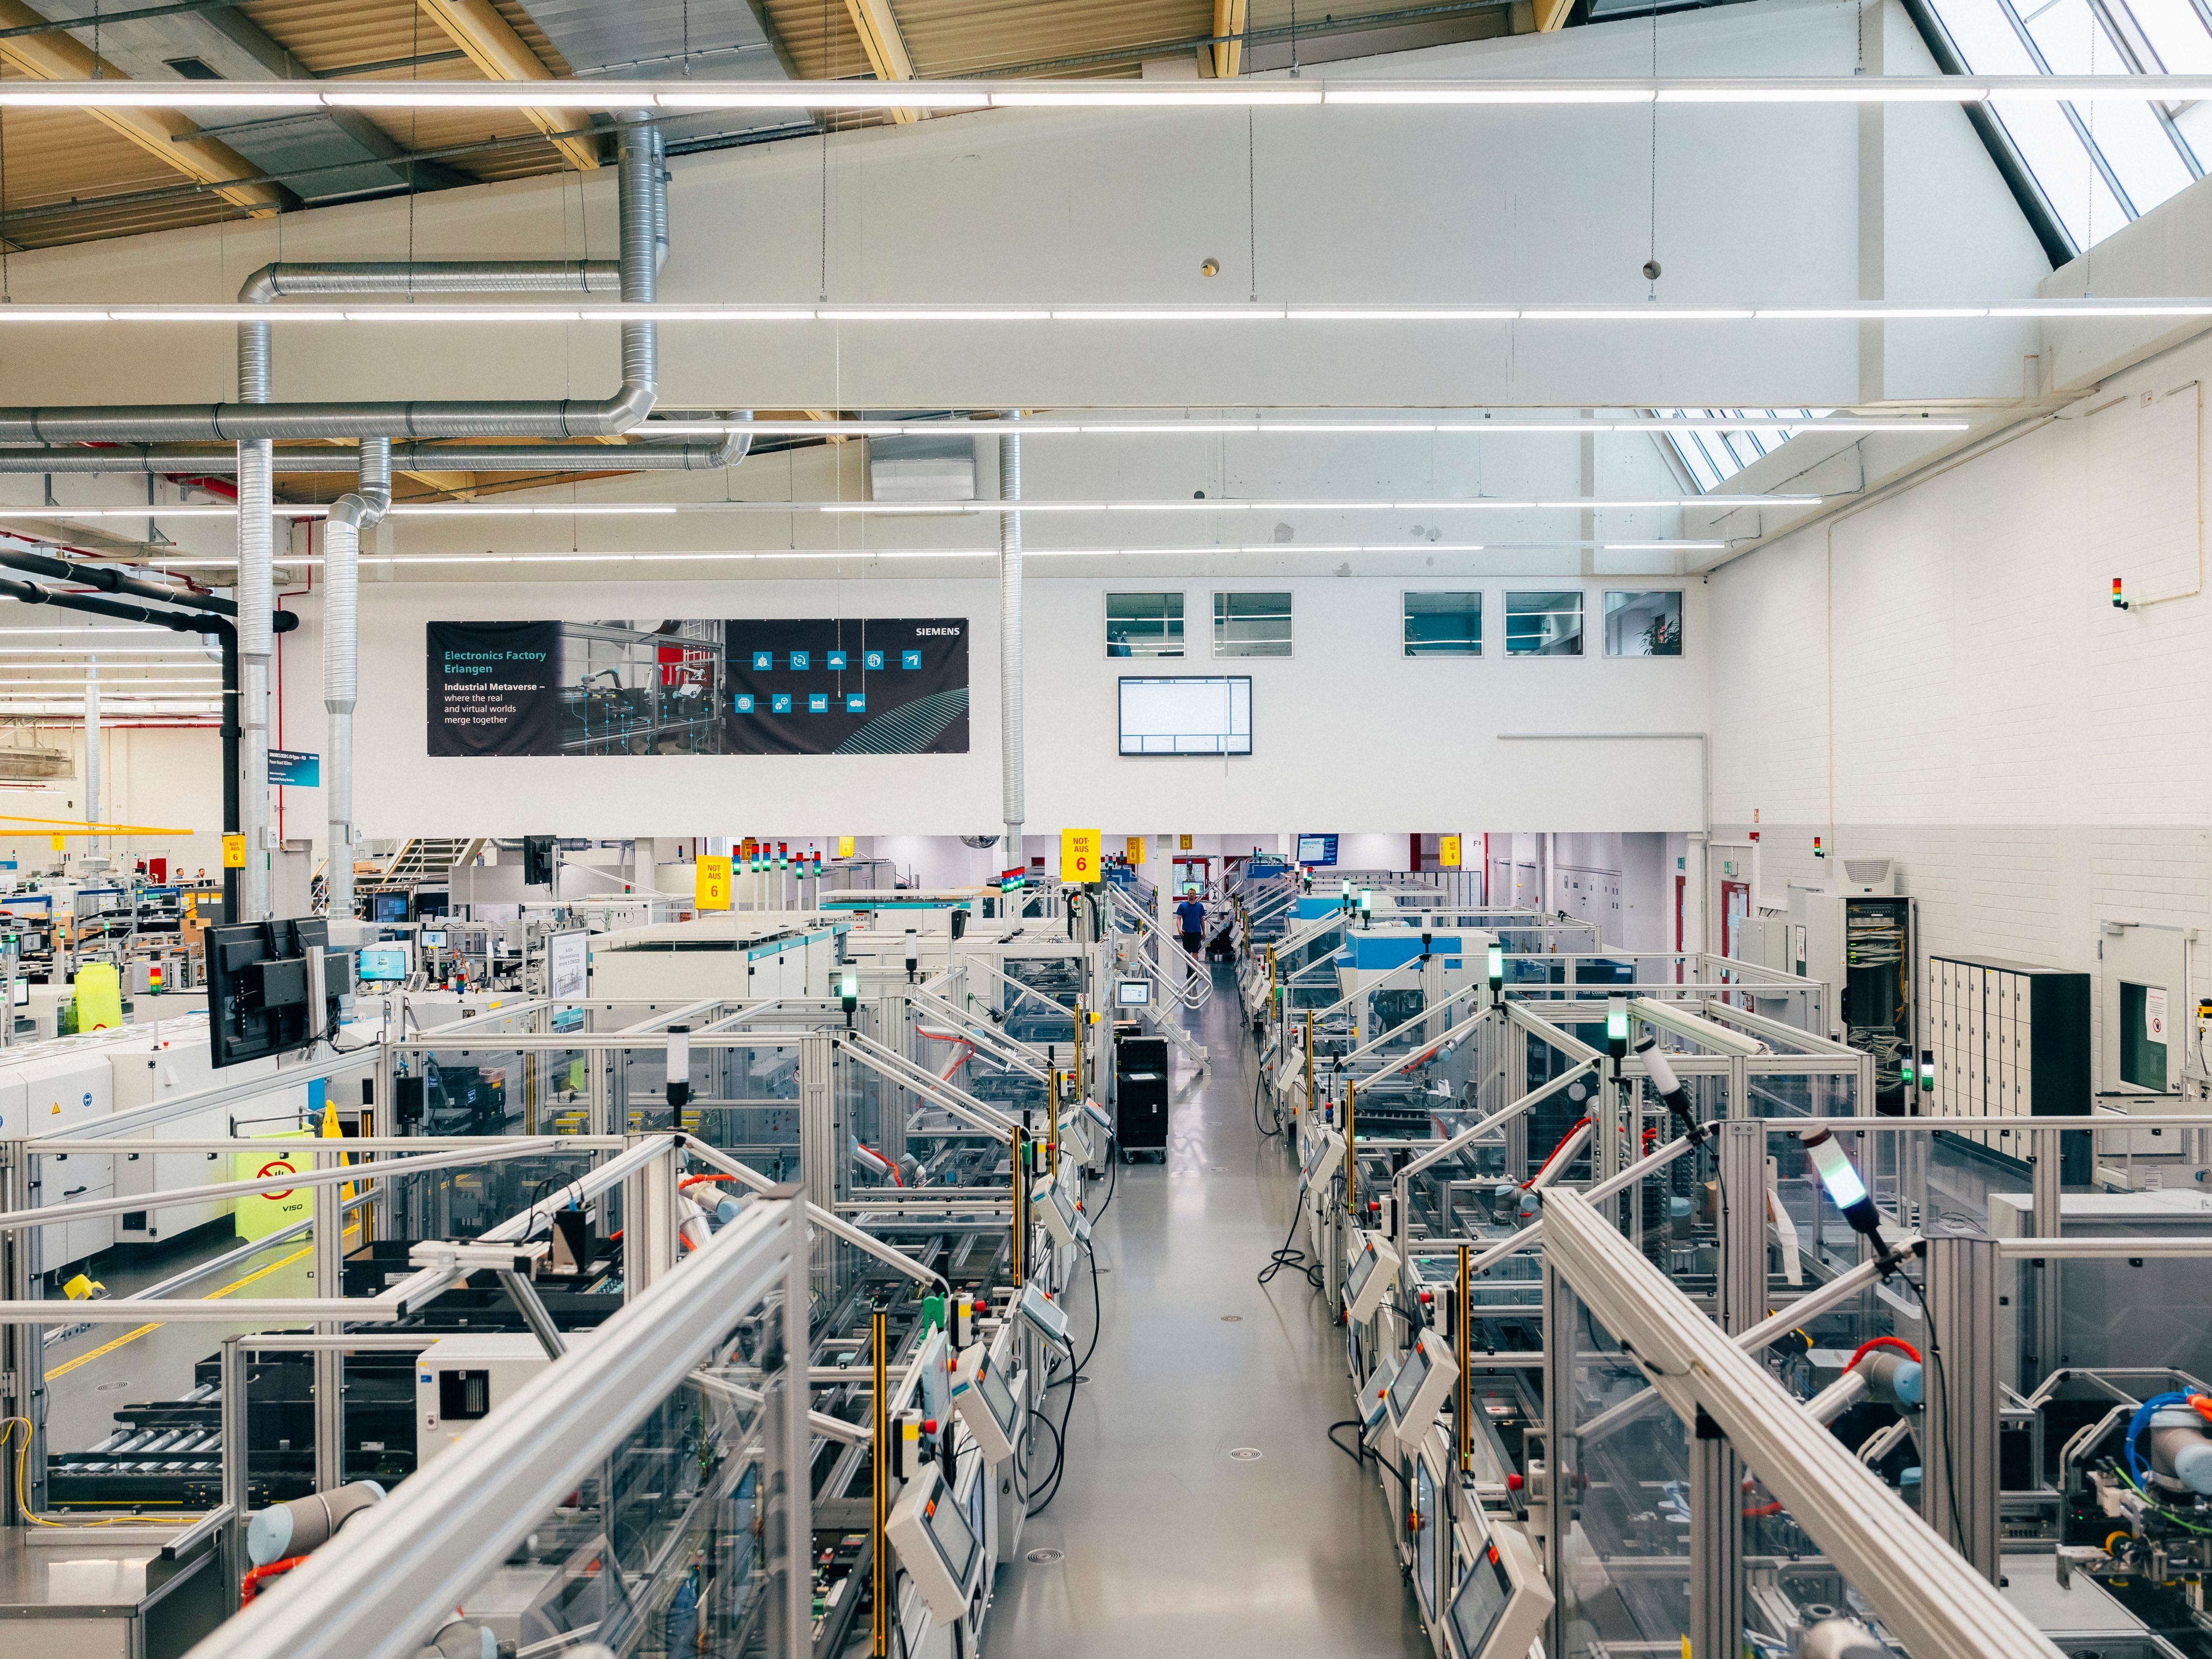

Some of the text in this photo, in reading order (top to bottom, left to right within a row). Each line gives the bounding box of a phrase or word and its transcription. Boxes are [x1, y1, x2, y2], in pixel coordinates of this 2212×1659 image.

[916, 627, 960, 636] SIEMENS
[445, 651, 546, 662] Electronics Factory
[445, 664, 493, 675] Erlangen
[444, 705, 516, 713] and virtual worlds
[444, 716, 507, 726] merge together
[1076, 857, 1087, 871] 6
[711, 885, 718, 897] 6
[283, 1204, 303, 1212] VISO
